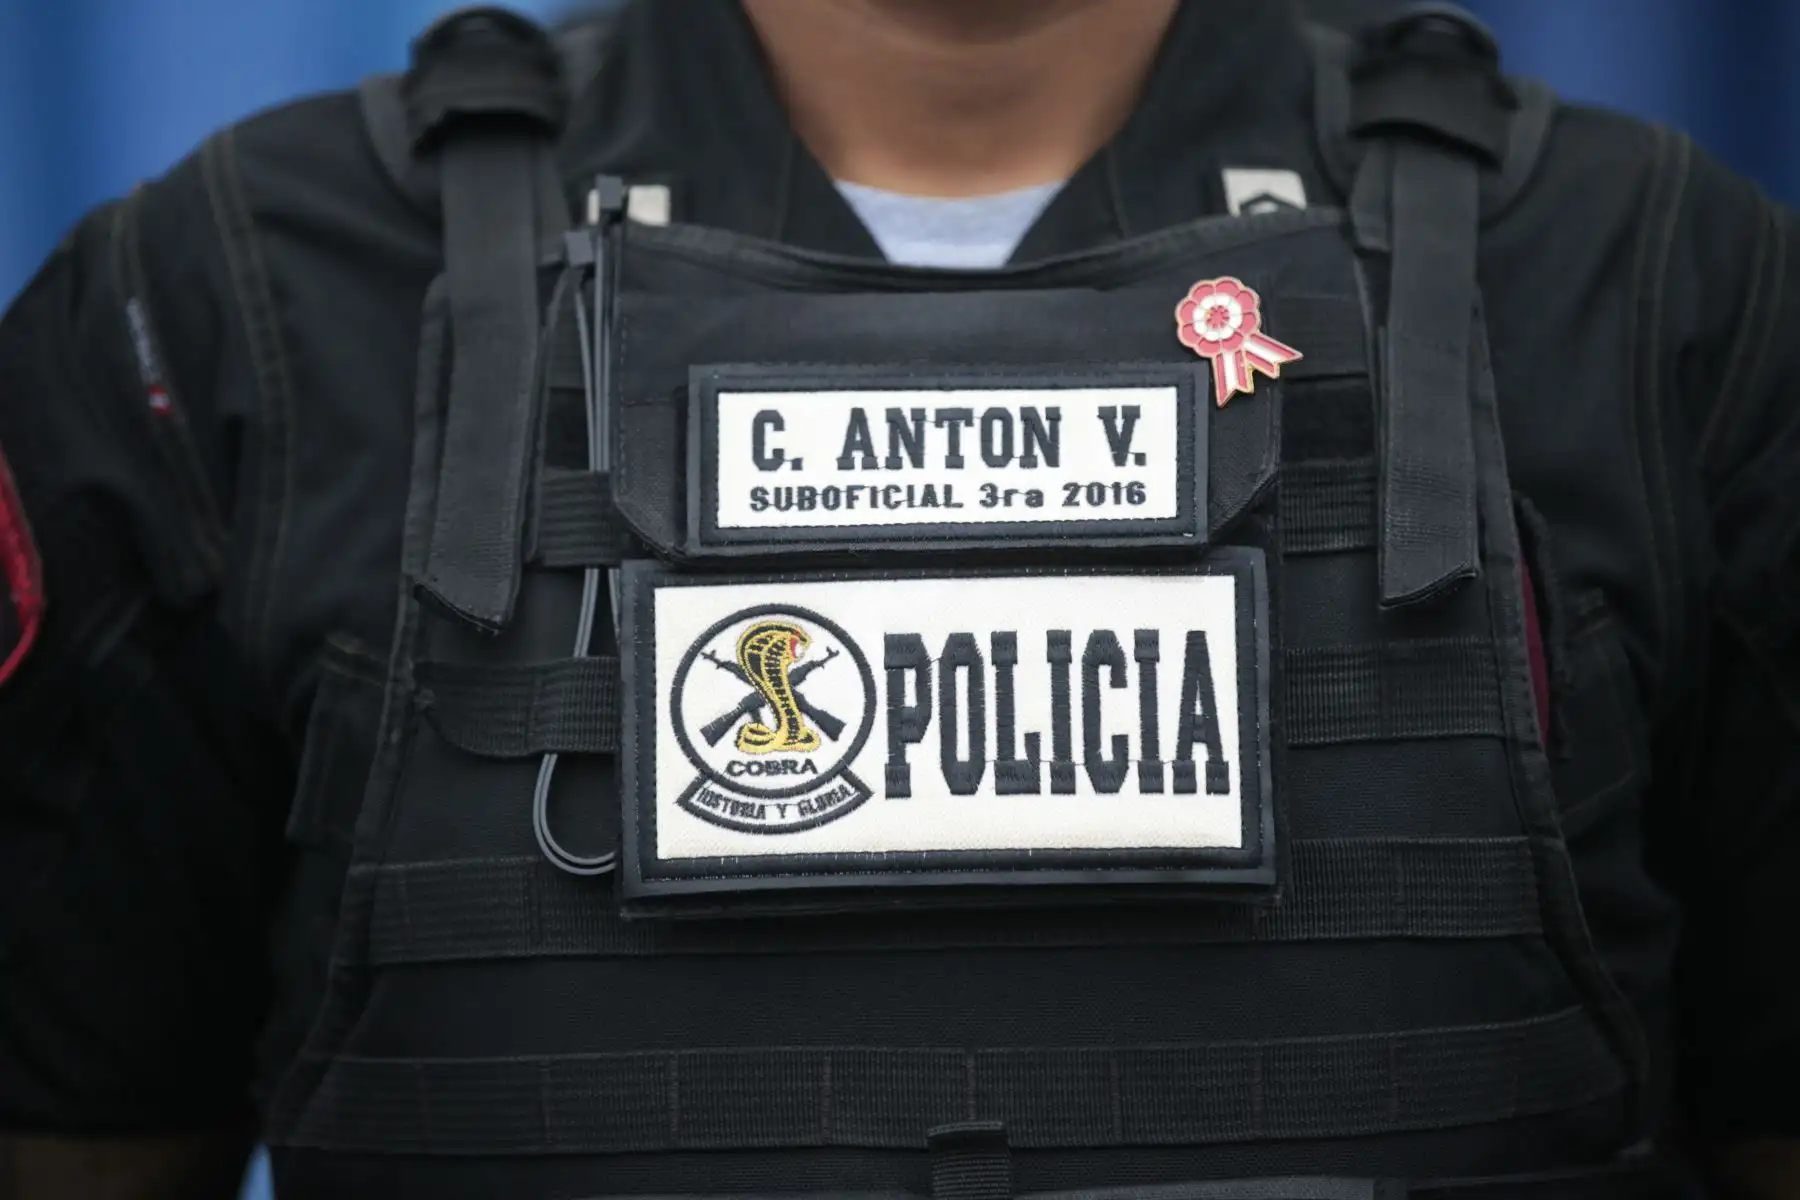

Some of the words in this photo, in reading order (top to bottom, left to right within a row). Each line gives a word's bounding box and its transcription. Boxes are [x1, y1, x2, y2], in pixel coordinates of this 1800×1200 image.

[752, 409, 803, 472] C.
[837, 407, 1062, 471] ANTON
[1097, 405, 1146, 467] V.
[750, 484, 963, 512] SUBOFICIAL
[979, 483, 1044, 508] 3ra
[1062, 481, 1146, 507] 2016
[883, 628, 1231, 800] POLICIA
[725, 758, 818, 778] COBRA
[697, 788, 767, 820] HISTORIA
[776, 804, 789, 819] Y
